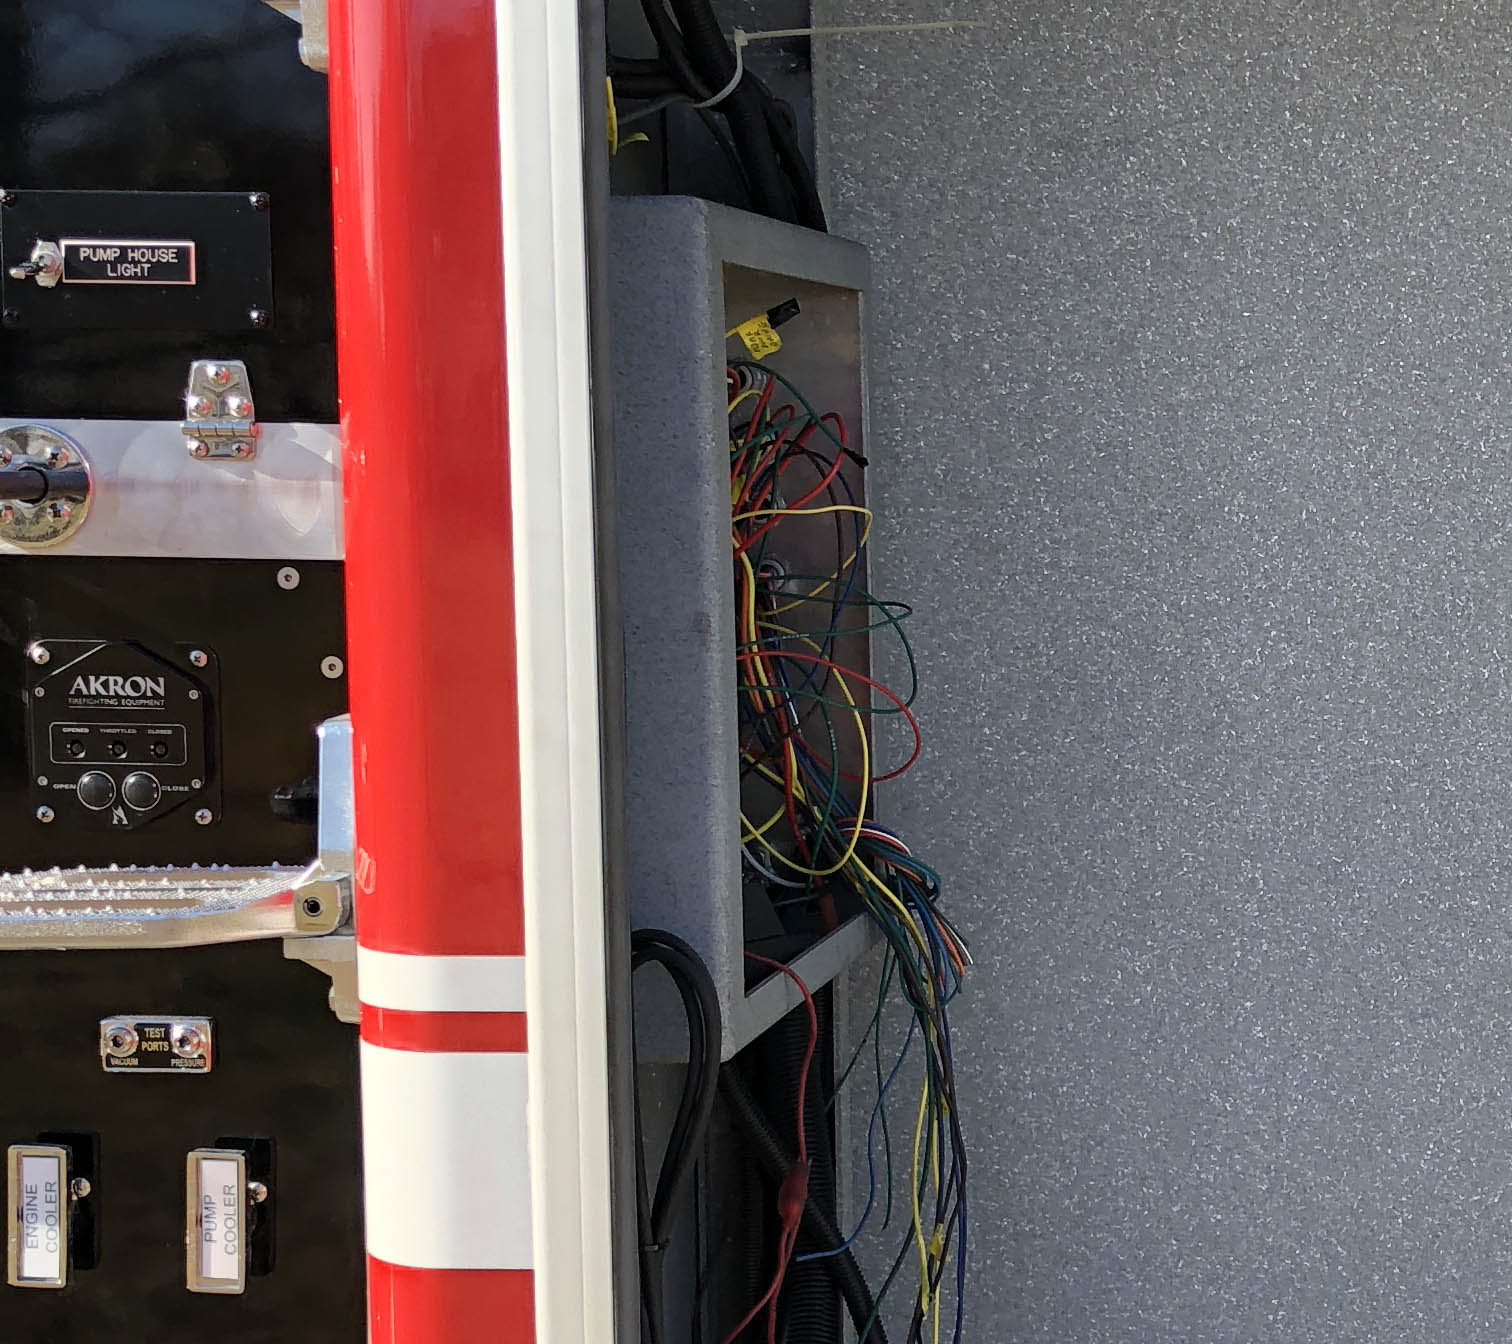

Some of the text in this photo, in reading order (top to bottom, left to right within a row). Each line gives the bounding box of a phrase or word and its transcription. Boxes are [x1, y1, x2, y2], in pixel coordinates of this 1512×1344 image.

[79, 247, 179, 263] PUMP HOUSE
[106, 263, 152, 278] LIGHT
[69, 675, 165, 697] AKRON
[68, 698, 165, 707] FIREFIGHTING EQUIPMENT
[52, 783, 77, 791] OPEN
[161, 784, 190, 792] CLOSE
[143, 1027, 165, 1039] TEST
[141, 1040, 170, 1052] PORTS
[110, 1056, 139, 1066] VACUUM
[170, 1057, 206, 1068] PRESSURE
[24, 1183, 39, 1250] ENGINE
[45, 1180, 59, 1254] COOLER
[204, 1194, 217, 1244] PUMP
[224, 1183, 237, 1256] COOLER
